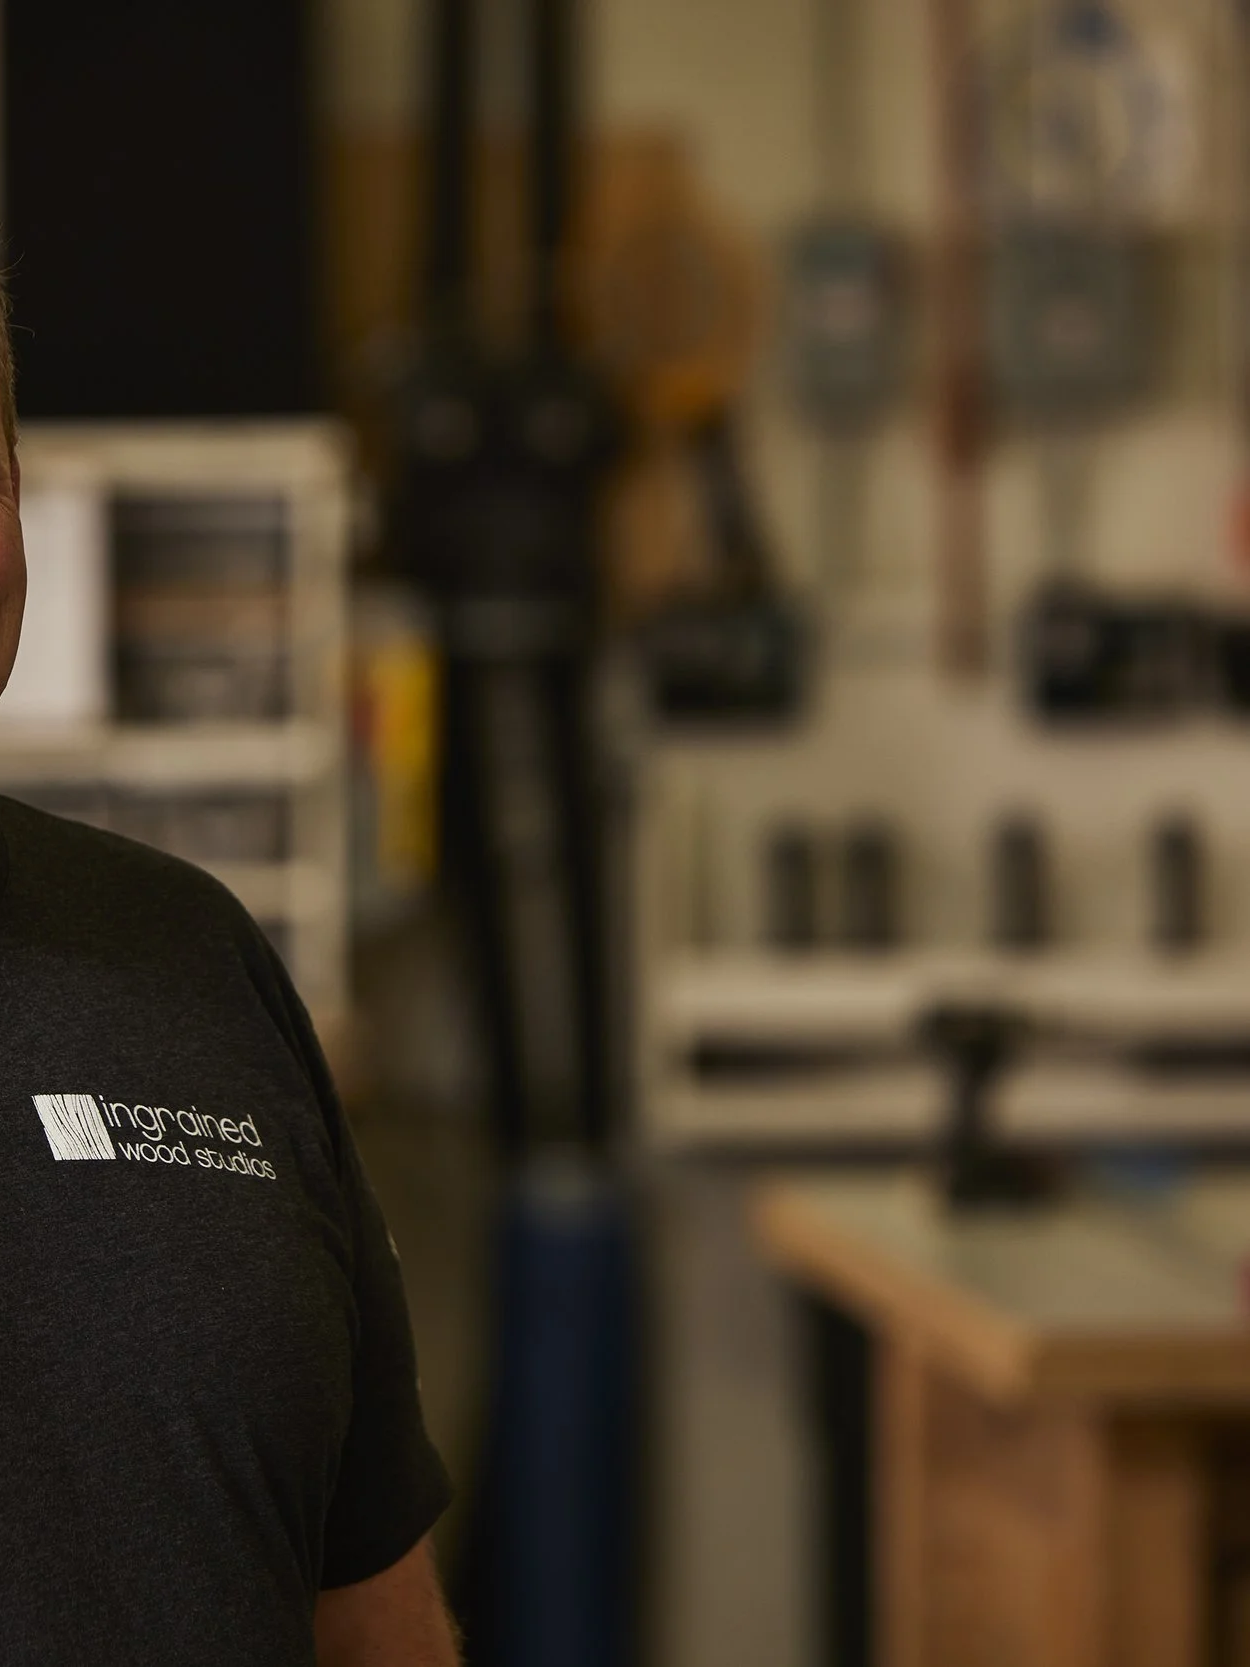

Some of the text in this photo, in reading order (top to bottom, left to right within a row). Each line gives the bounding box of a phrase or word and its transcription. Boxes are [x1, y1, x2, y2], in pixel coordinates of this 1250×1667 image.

[99, 1094, 263, 1147] ingrained
[118, 1141, 277, 1180] wood studios
